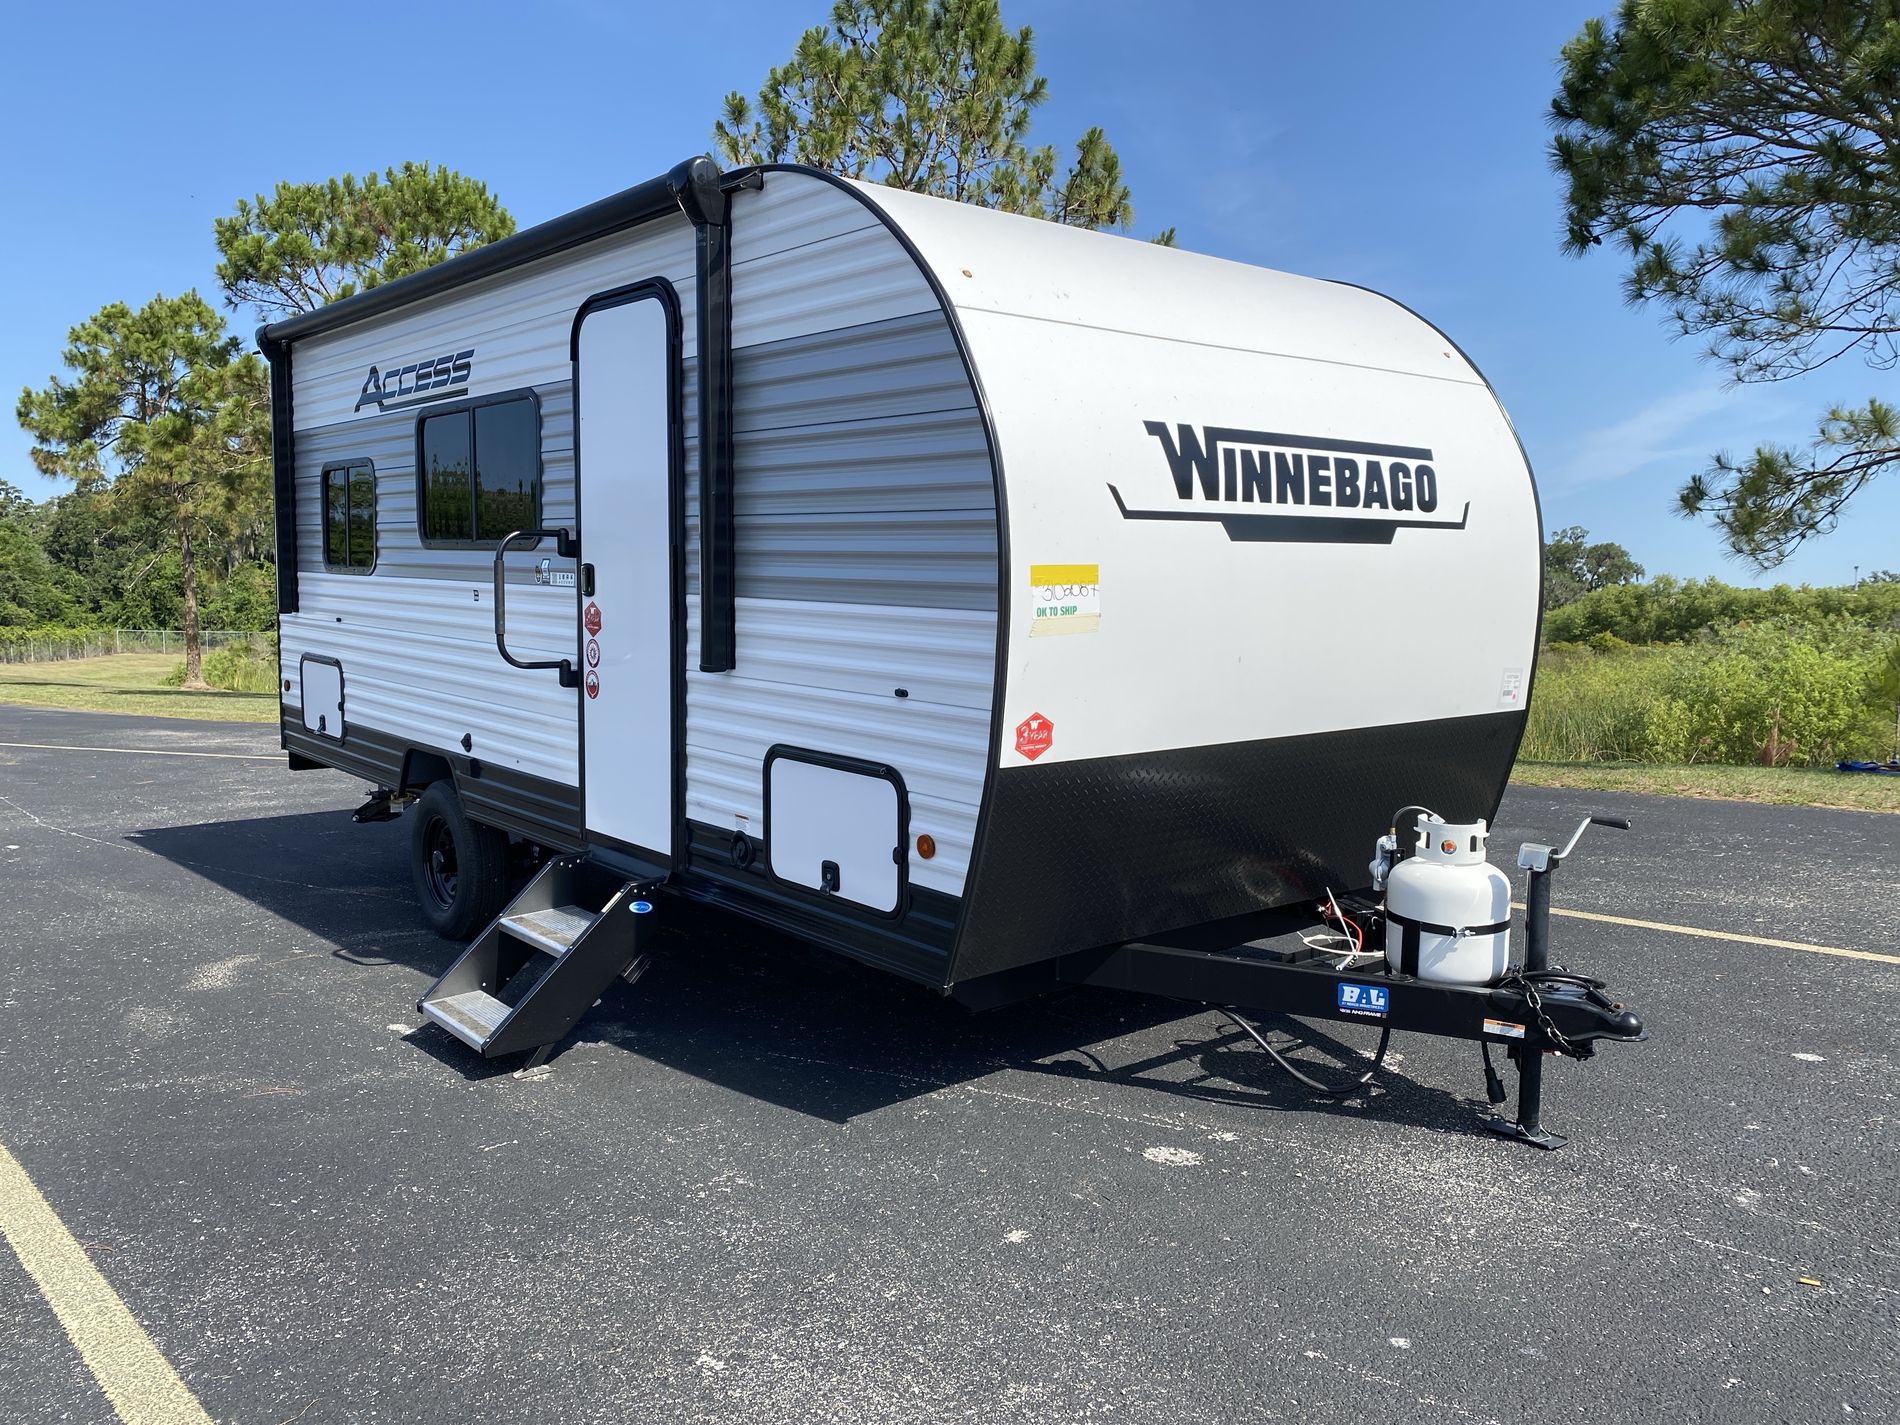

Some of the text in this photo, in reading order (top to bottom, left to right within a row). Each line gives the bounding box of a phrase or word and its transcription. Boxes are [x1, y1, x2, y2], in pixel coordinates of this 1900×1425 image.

[354, 349, 475, 413] ACCESS
[1143, 420, 1438, 513] WINNEBAGO
[1036, 605, 1078, 617] OK TO SHIP
